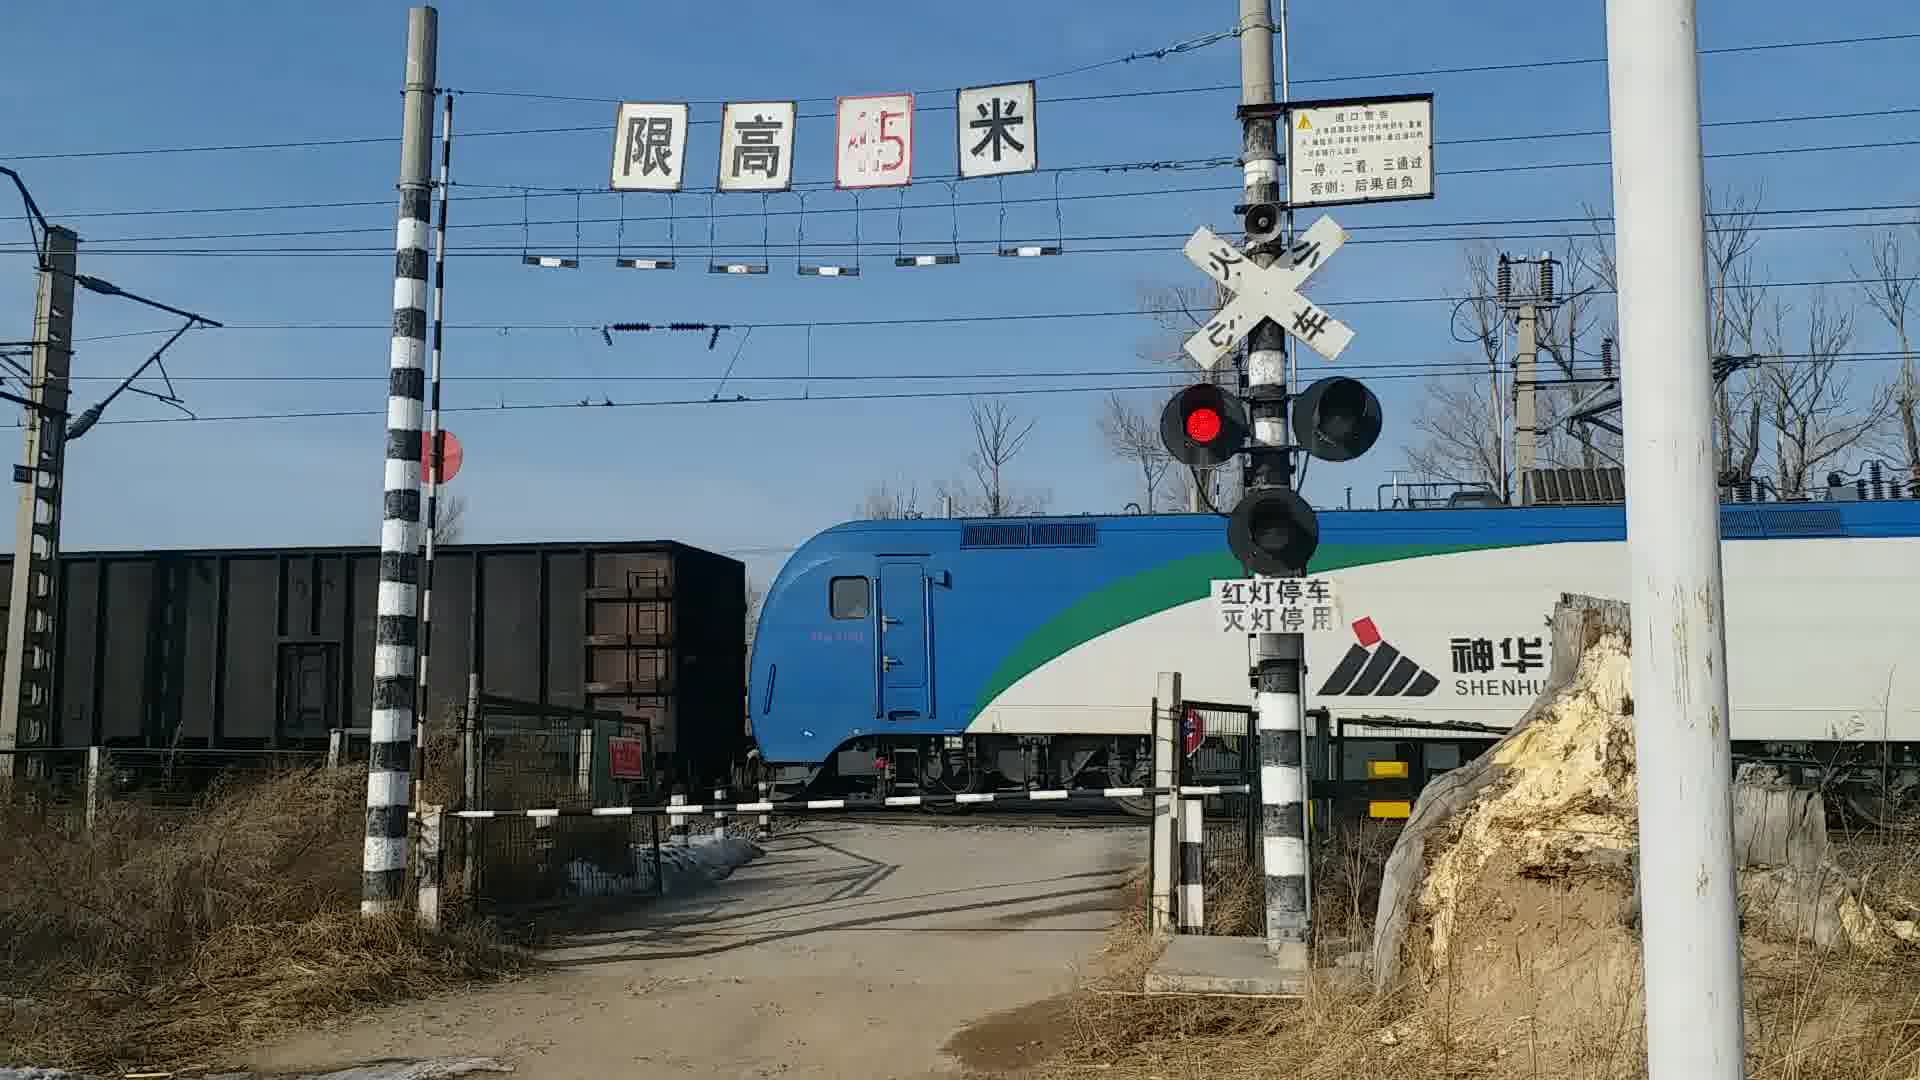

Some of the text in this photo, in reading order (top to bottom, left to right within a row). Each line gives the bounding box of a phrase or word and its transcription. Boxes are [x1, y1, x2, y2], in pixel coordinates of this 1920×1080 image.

[623, 116, 673, 176] 限
[732, 113, 784, 177] 高
[970, 97, 1025, 162] 米
[1208, 247, 1328, 341] 火 车
[1221, 579, 1330, 604] 红灯停车
[1222, 606, 1332, 632] 灭灯停用
